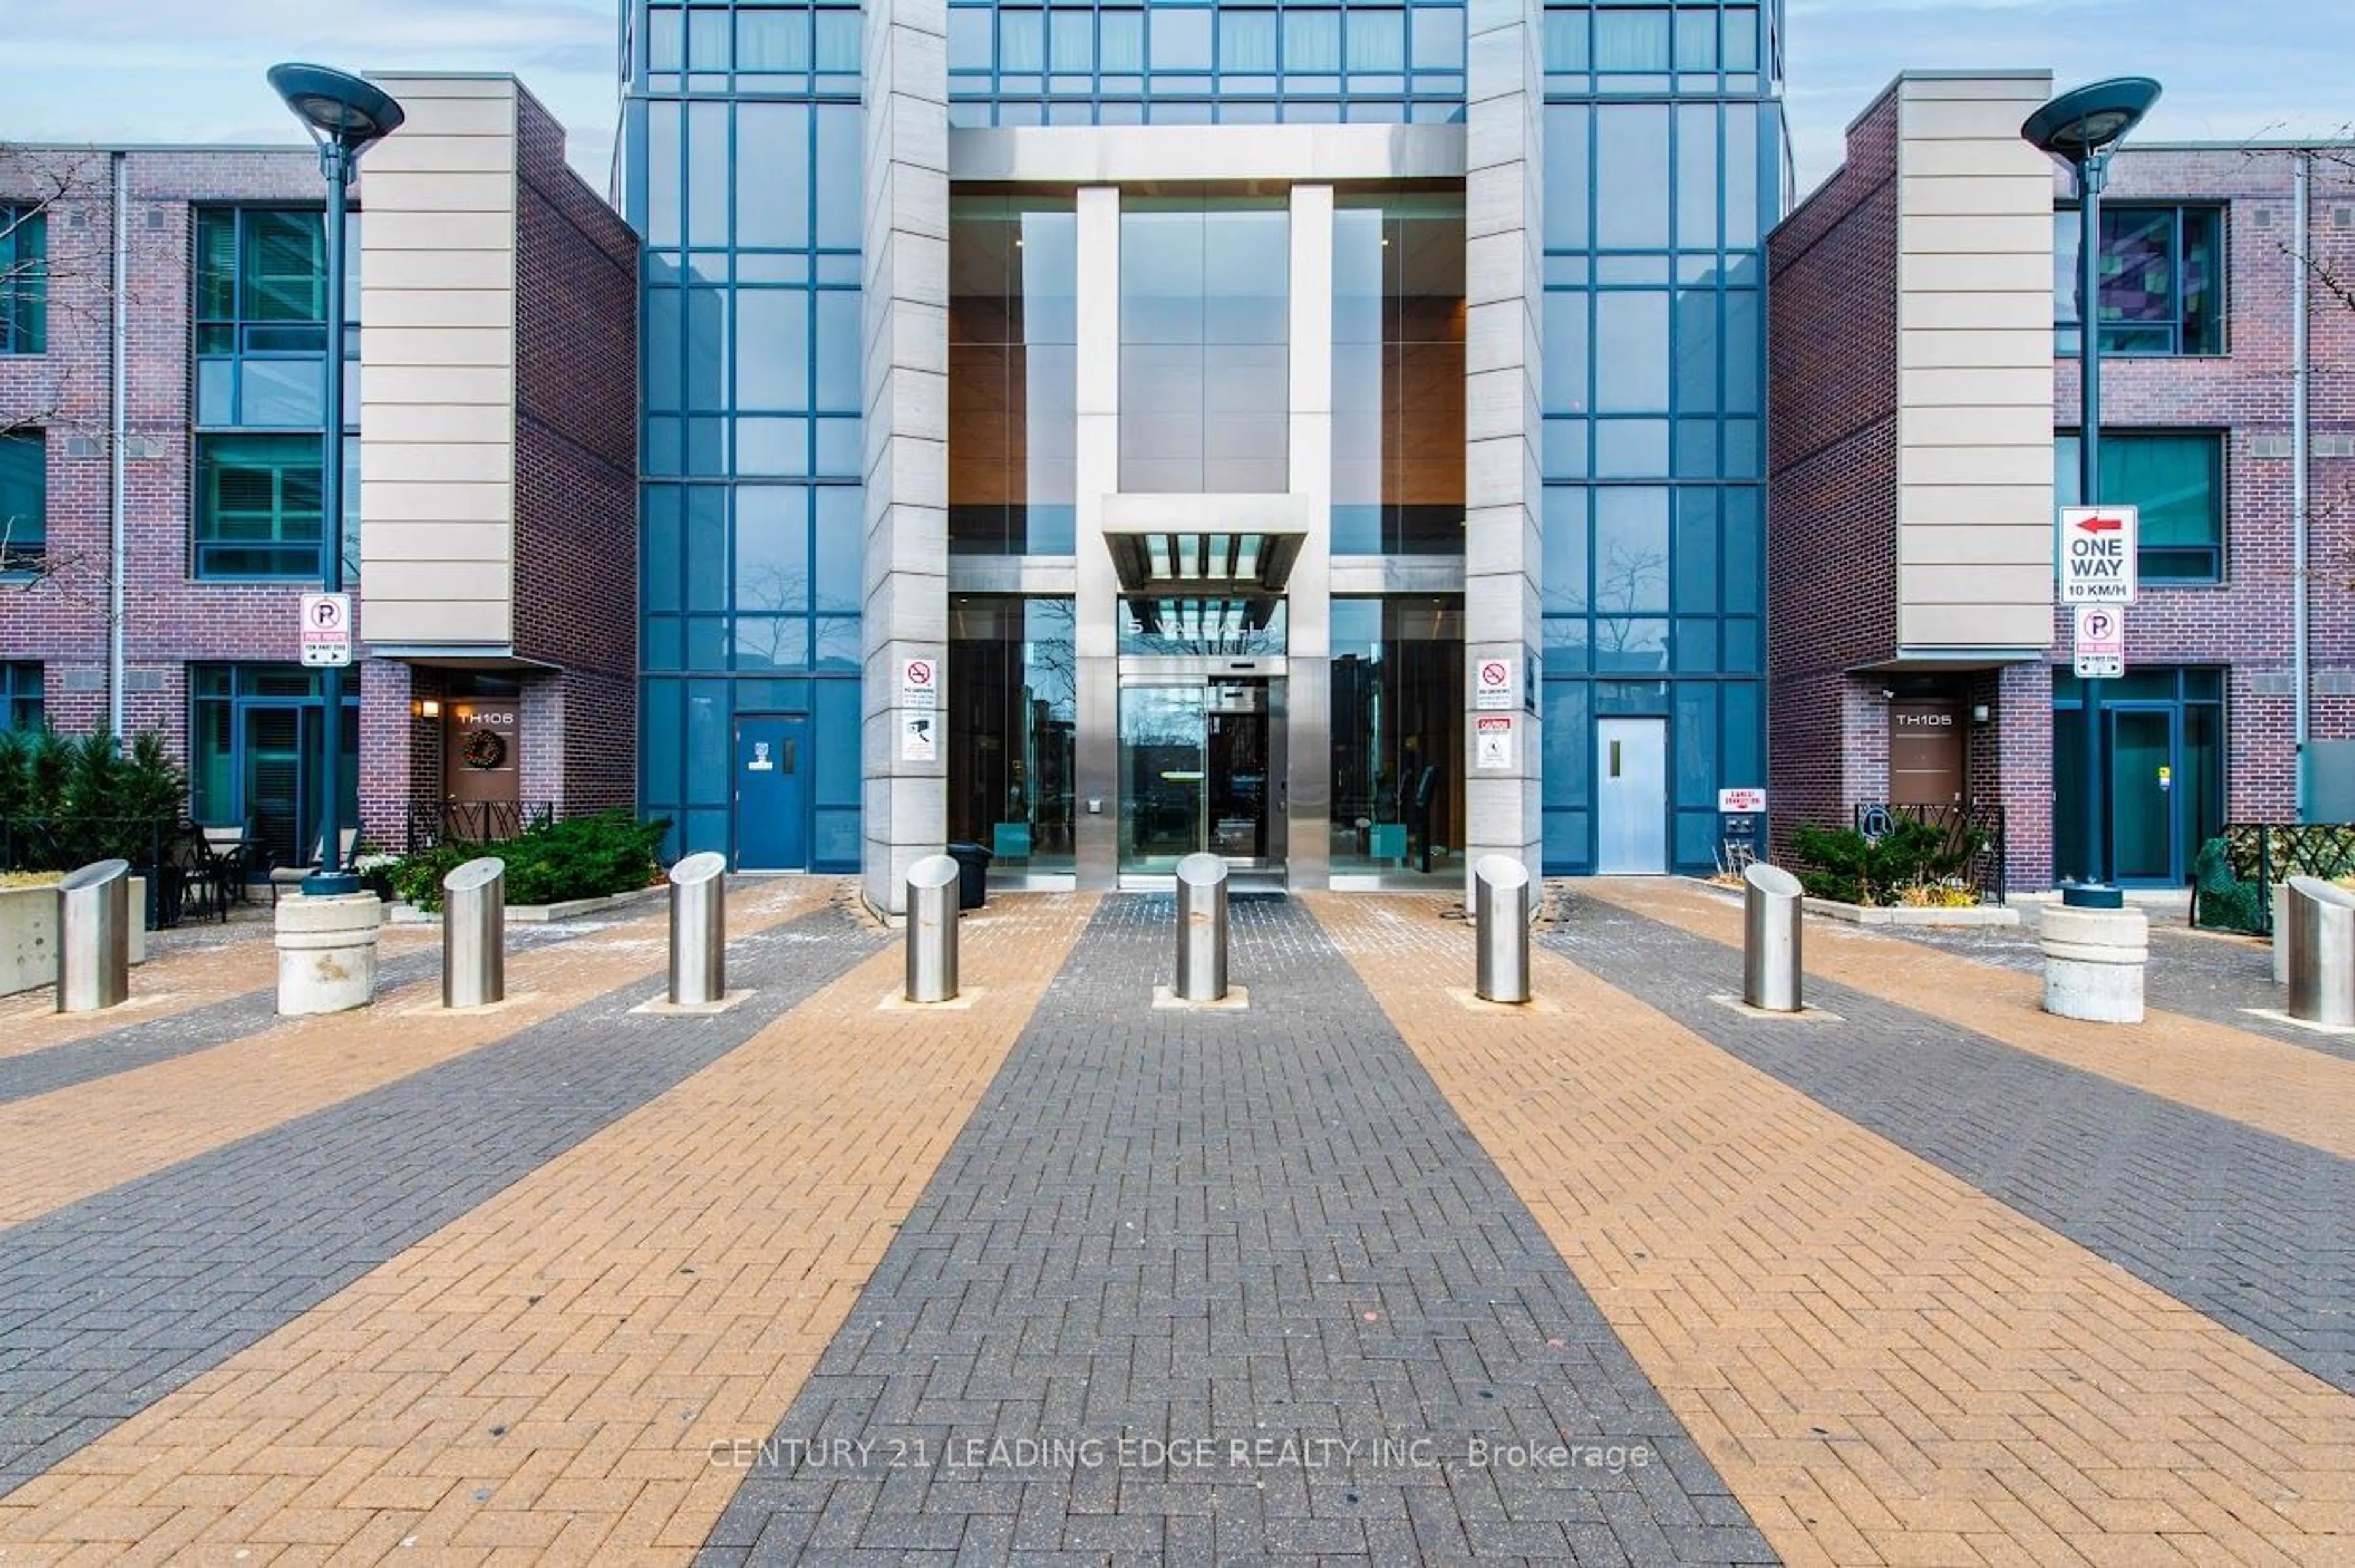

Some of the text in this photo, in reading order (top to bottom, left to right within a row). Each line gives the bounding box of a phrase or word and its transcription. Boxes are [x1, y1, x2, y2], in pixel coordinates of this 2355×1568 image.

[2072, 538, 2123, 556] ONE
[2070, 559, 2123, 576] WAY
[2069, 584, 2127, 596] 10 KM/H
[1128, 619, 1144, 634] 5
[1896, 714, 1953, 725] TH105
